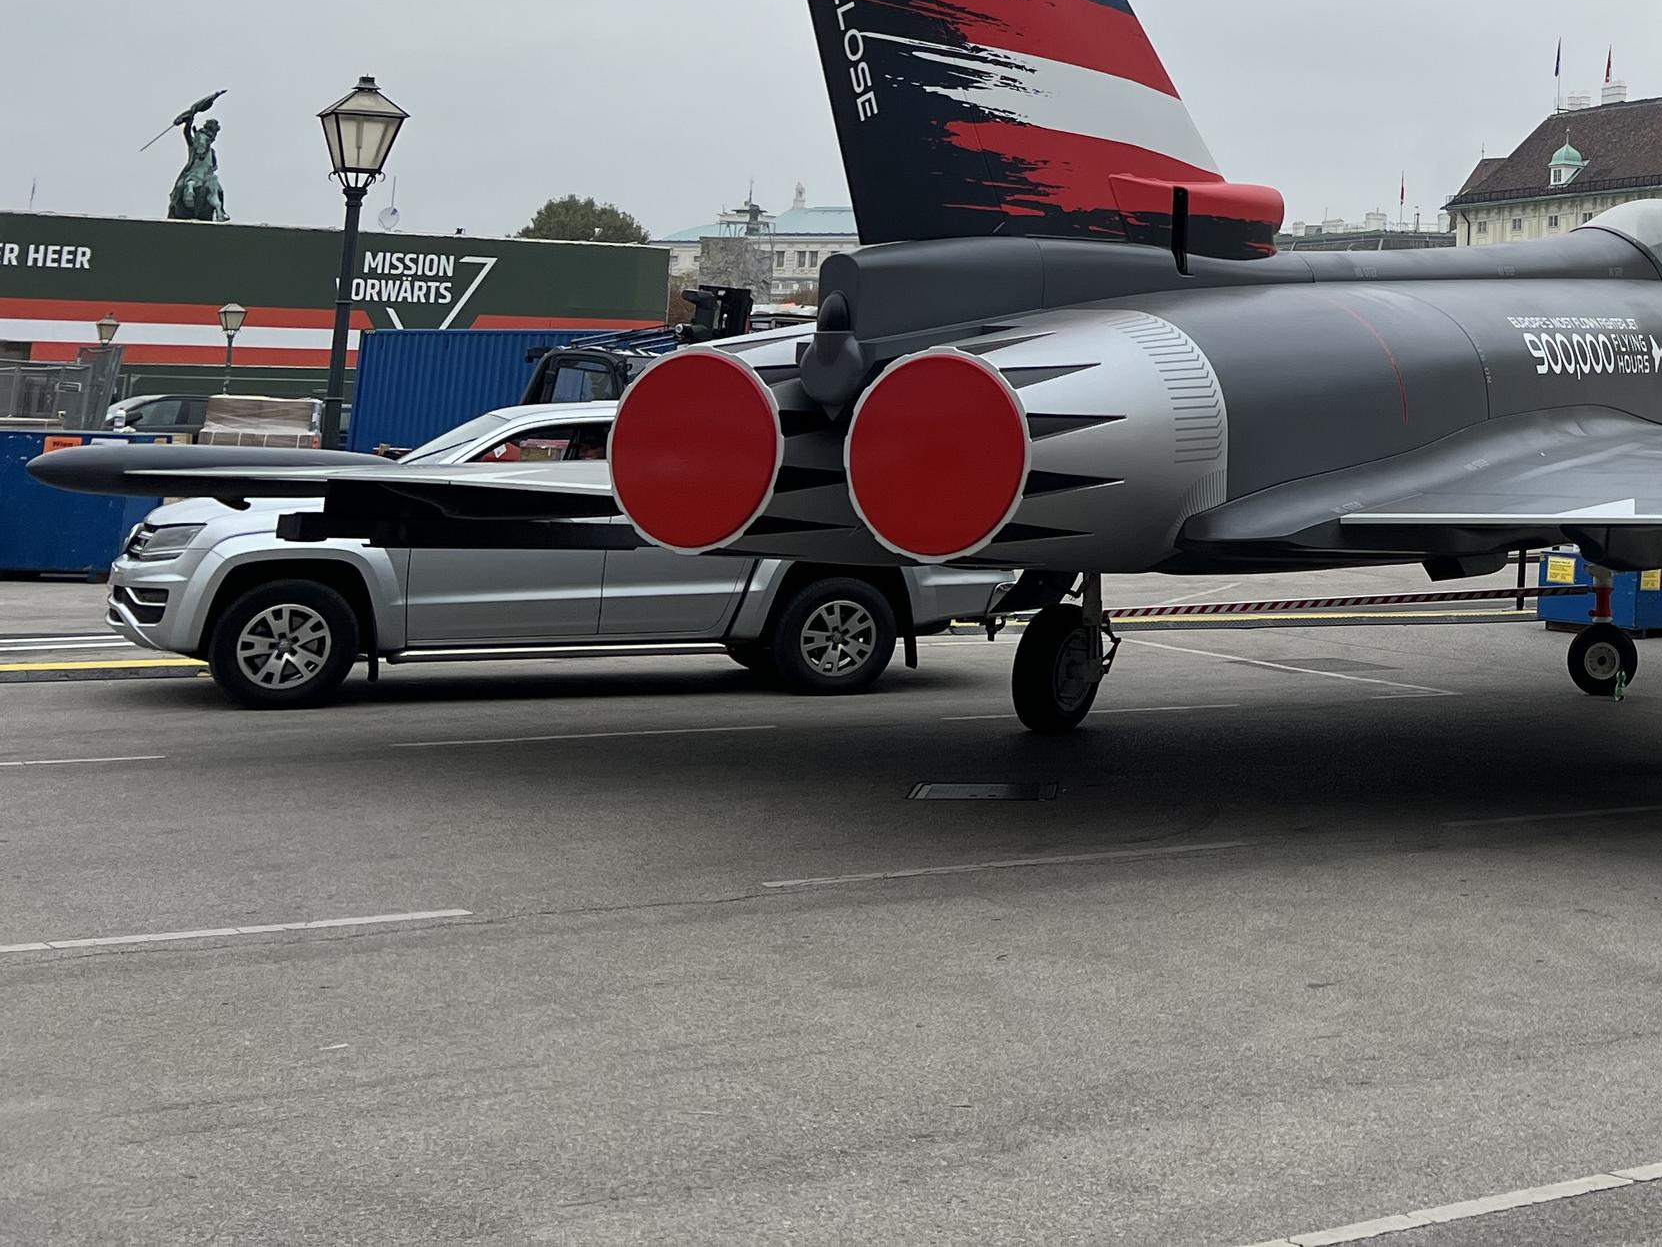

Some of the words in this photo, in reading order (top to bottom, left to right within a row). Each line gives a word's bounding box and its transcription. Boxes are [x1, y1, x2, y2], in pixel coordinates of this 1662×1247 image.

[27, 244, 92, 269] HEER
[363, 251, 455, 277] MISSION
[336, 276, 452, 304] ORWÄRTS
[1523, 333, 1615, 380] 900,000
[1610, 334, 1647, 352] FLYING
[1617, 355, 1650, 373] HOURS
